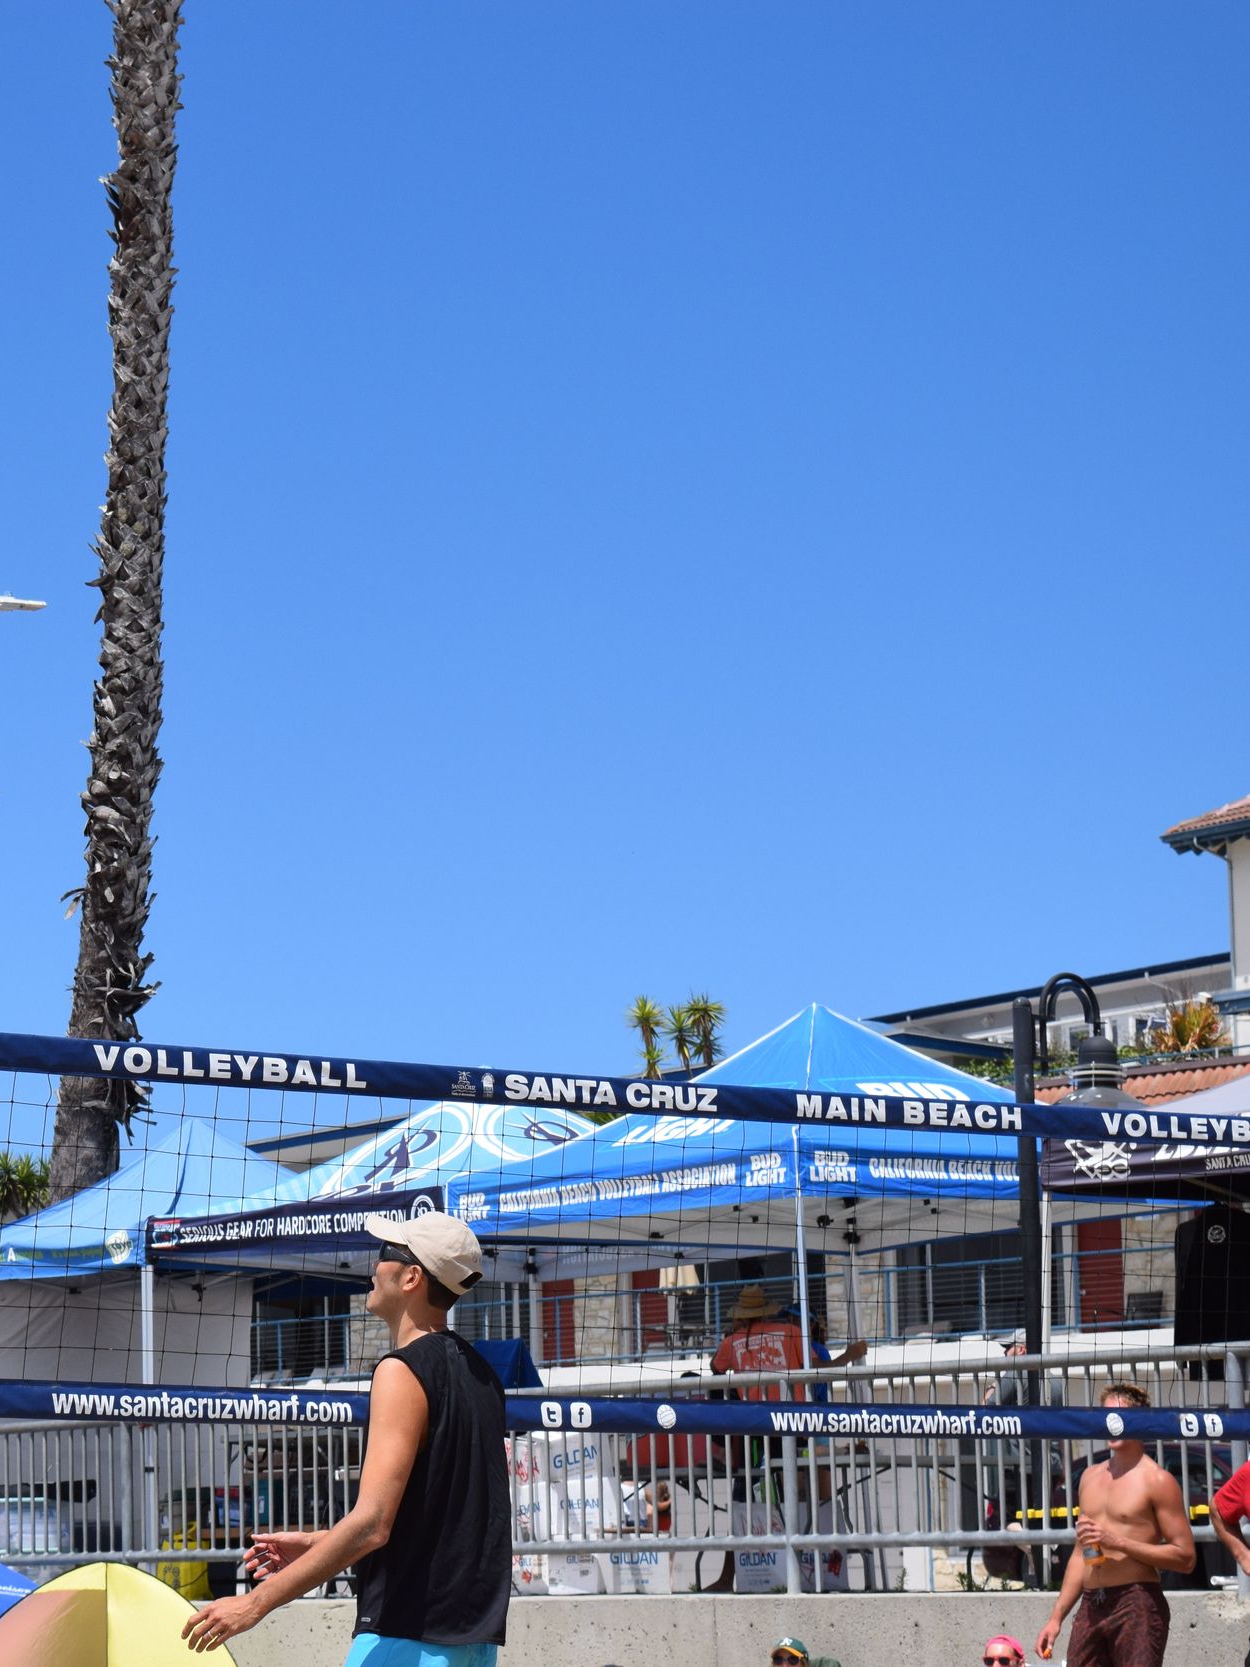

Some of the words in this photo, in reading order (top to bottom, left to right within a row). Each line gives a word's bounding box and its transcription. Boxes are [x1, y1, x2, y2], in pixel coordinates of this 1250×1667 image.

[93, 1044, 367, 1089] VOLLEYBALL
[504, 1074, 617, 1106] SANTA
[625, 1082, 718, 1113] CRUZ
[796, 1094, 887, 1123] MAIN
[903, 1101, 1023, 1131] BEACH
[1101, 1112, 1250, 1143] VOLLEYB
[750, 1153, 782, 1169] BUD
[813, 1150, 850, 1167] BUD
[869, 1158, 948, 1180] CALIFORNIA
[948, 1161, 993, 1181] BEACH
[746, 1167, 787, 1187] LIGHT
[810, 1166, 858, 1182] LIGHT
[499, 1188, 560, 1213] CALIFORNIA
[561, 1182, 597, 1206] BEACH
[599, 1174, 660, 1200] VOLLEYBALL
[662, 1163, 736, 1192] ASSOCIATION
[459, 1192, 486, 1208] BUD
[180, 1223, 225, 1244] SERIOUS
[225, 1220, 252, 1240] GEAR
[254, 1218, 274, 1237] FOR
[276, 1214, 332, 1236] HARDCORE
[51, 1392, 353, 1423] www.santacruzwharf.com
[771, 1409, 1022, 1436] www.santacruzwharf.com
[553, 1445, 598, 1469] GLDAN
[739, 1552, 777, 1567] GILDAN
